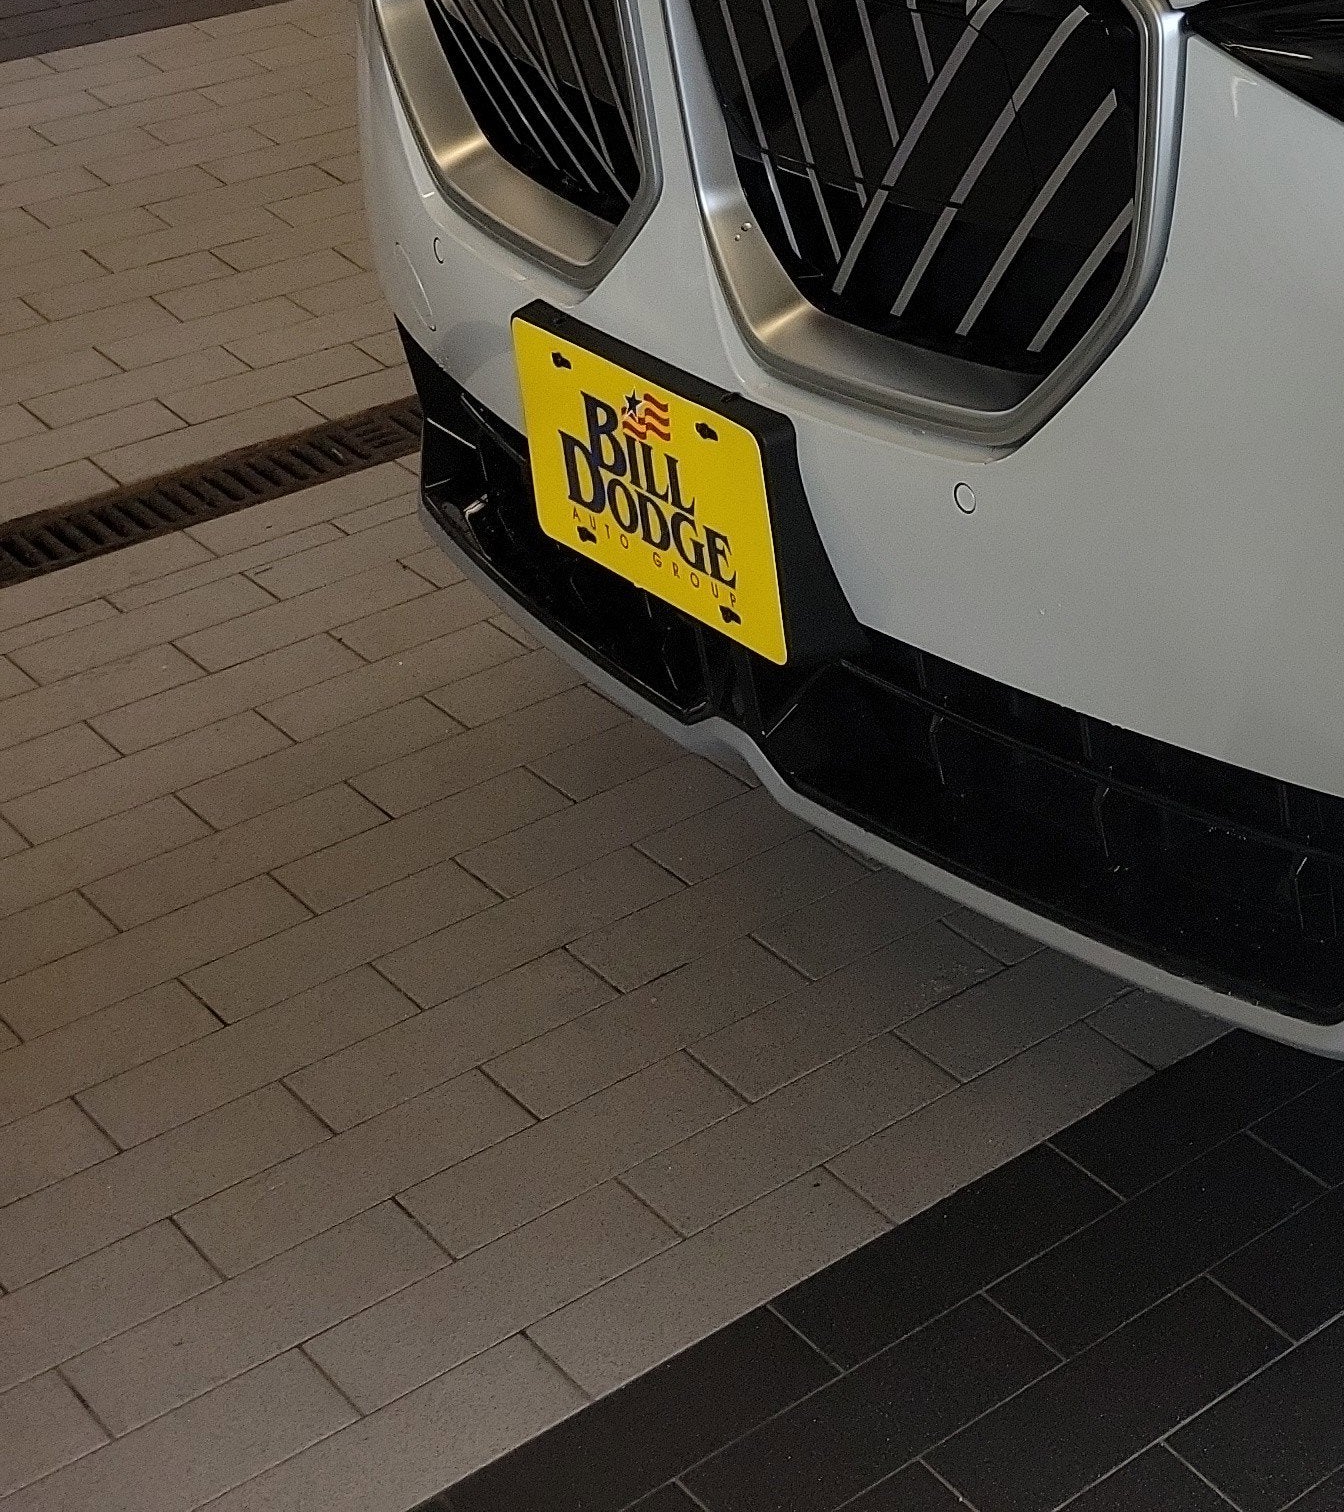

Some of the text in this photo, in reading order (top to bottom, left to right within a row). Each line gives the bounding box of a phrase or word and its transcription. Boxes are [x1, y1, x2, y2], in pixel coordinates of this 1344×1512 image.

[557, 428, 738, 590] DODGE
[579, 389, 696, 517] BILL
[572, 507, 737, 608] AUTO GROUP
